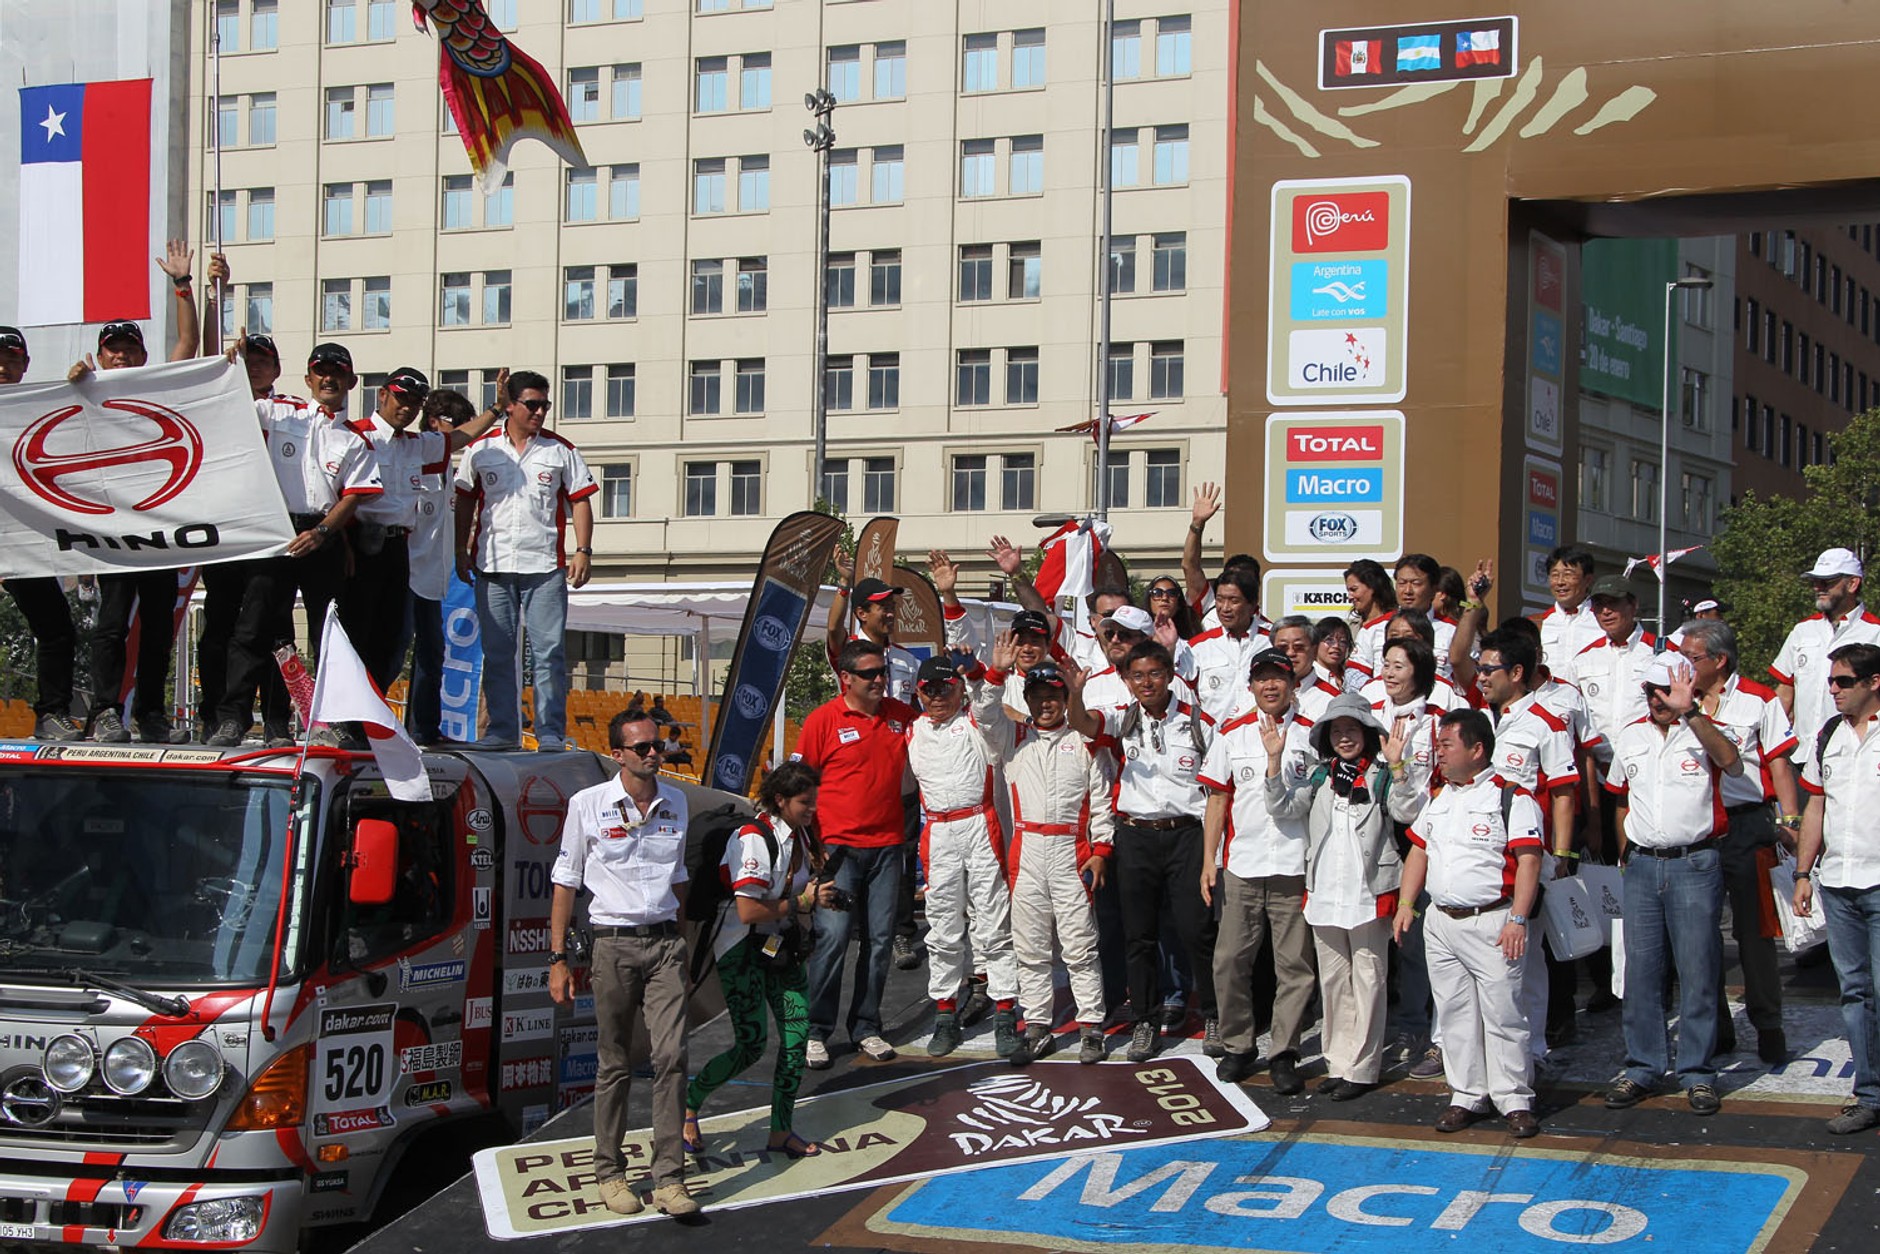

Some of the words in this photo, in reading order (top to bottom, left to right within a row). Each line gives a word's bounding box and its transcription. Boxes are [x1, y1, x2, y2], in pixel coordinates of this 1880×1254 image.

[1306, 201, 1375, 246] Perú
[1313, 264, 1362, 279] Argentina
[1312, 308, 1330, 317] Late
[1589, 306, 1610, 337] Dakar
[1616, 315, 1648, 352] Santiago
[1589, 343, 1599, 371] 20
[1600, 347, 1609, 374] de
[1610, 358, 1630, 380] enero
[1303, 362, 1357, 382] Chile
[1294, 434, 1376, 453] TOTAL
[1297, 475, 1370, 495] Macro
[1319, 518, 1347, 532] FOX
[57, 524, 220, 551] HINO
[761, 619, 783, 641] FOX
[898, 618, 928, 634] DAKAR
[742, 689, 760, 709] FOX
[67, 748, 87, 758] PERU
[88, 750, 132, 760] ARGENTINA
[133, 751, 155, 760] CHILE
[166, 751, 217, 761] dakar.com
[471, 854, 494, 866] KTEL
[413, 964, 465, 981] MICHELIN
[325, 1013, 391, 1032] dakar.com
[527, 1019, 552, 1031] LINE
[0, 1034, 53, 1051] HIN
[325, 1043, 385, 1102] 520
[422, 1083, 449, 1102] M.A.R.
[1134, 1068, 1217, 1126] 2013
[329, 1116, 378, 1130] TOTAL
[949, 1113, 1148, 1156] DAKAR
[514, 1140, 656, 1174] PER
[1018, 1153, 1648, 1245] Macro
